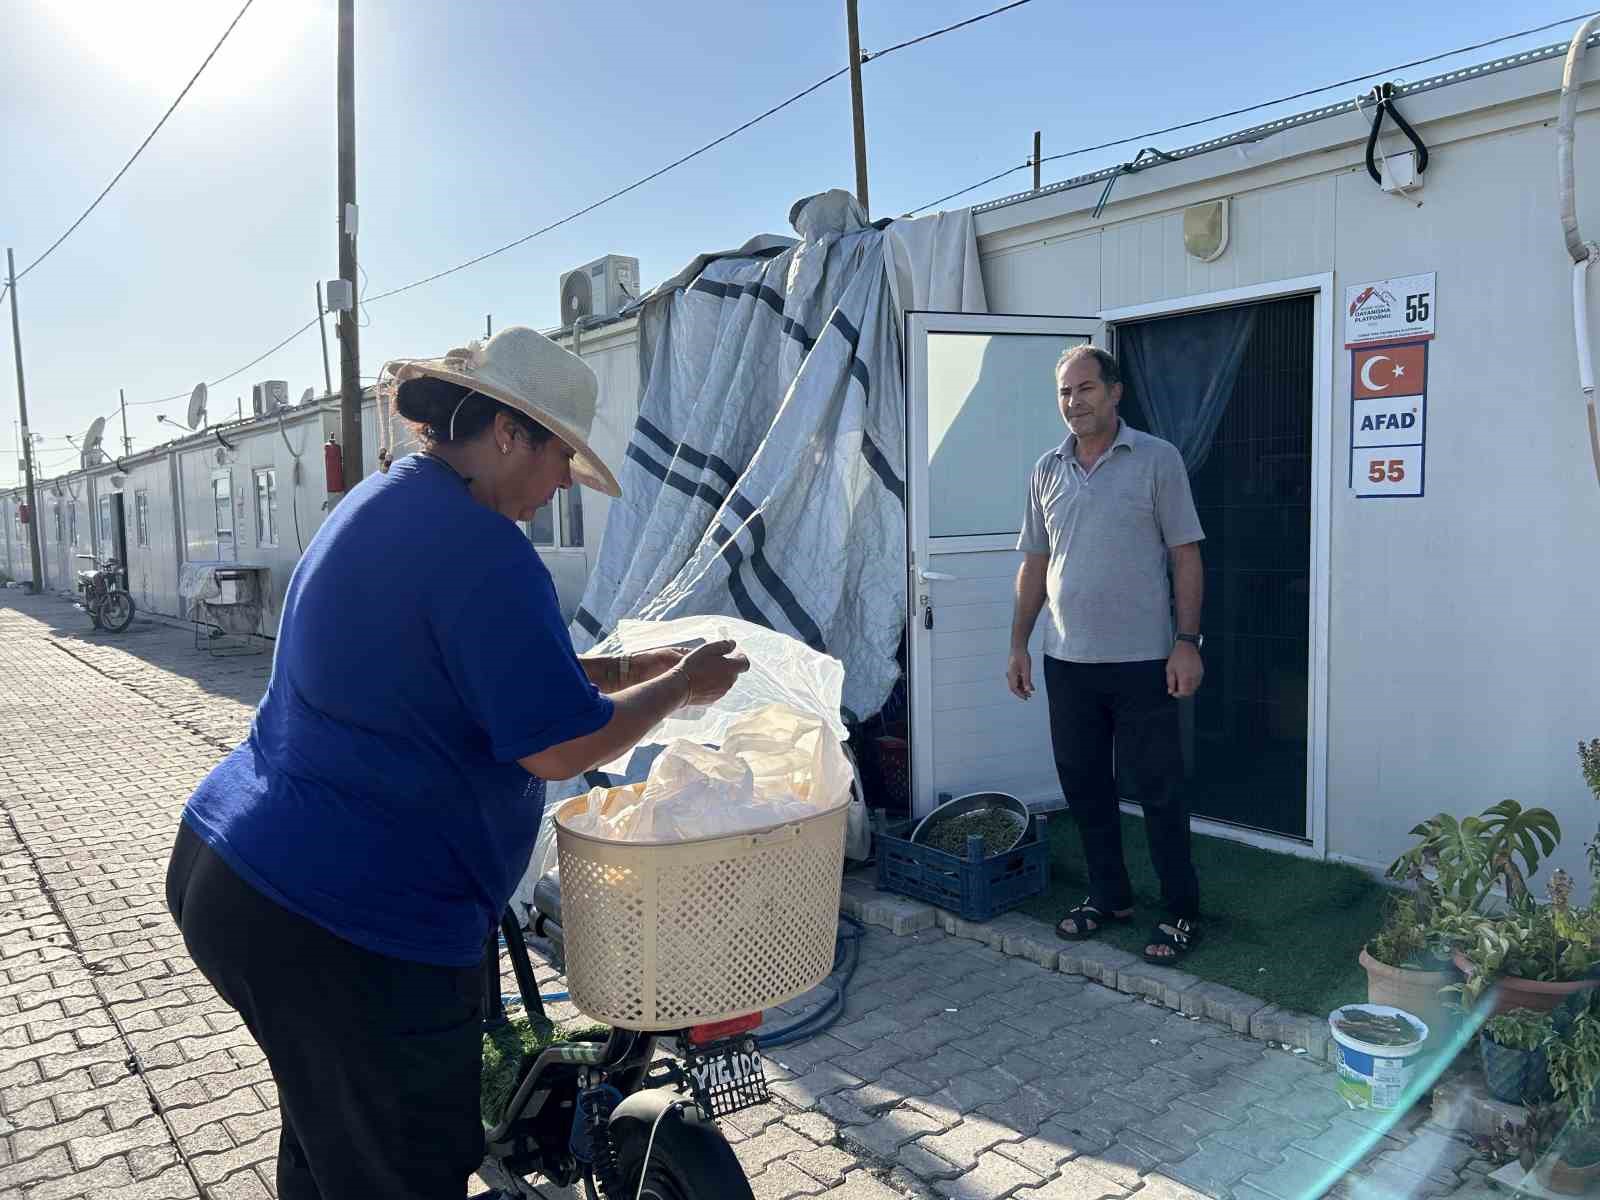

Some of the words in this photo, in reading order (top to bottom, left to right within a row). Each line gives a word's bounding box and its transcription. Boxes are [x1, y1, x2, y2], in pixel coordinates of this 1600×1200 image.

[1405, 292, 1430, 323] 55
[1360, 412, 1416, 431] AFAD
[1367, 459, 1405, 483] 55
